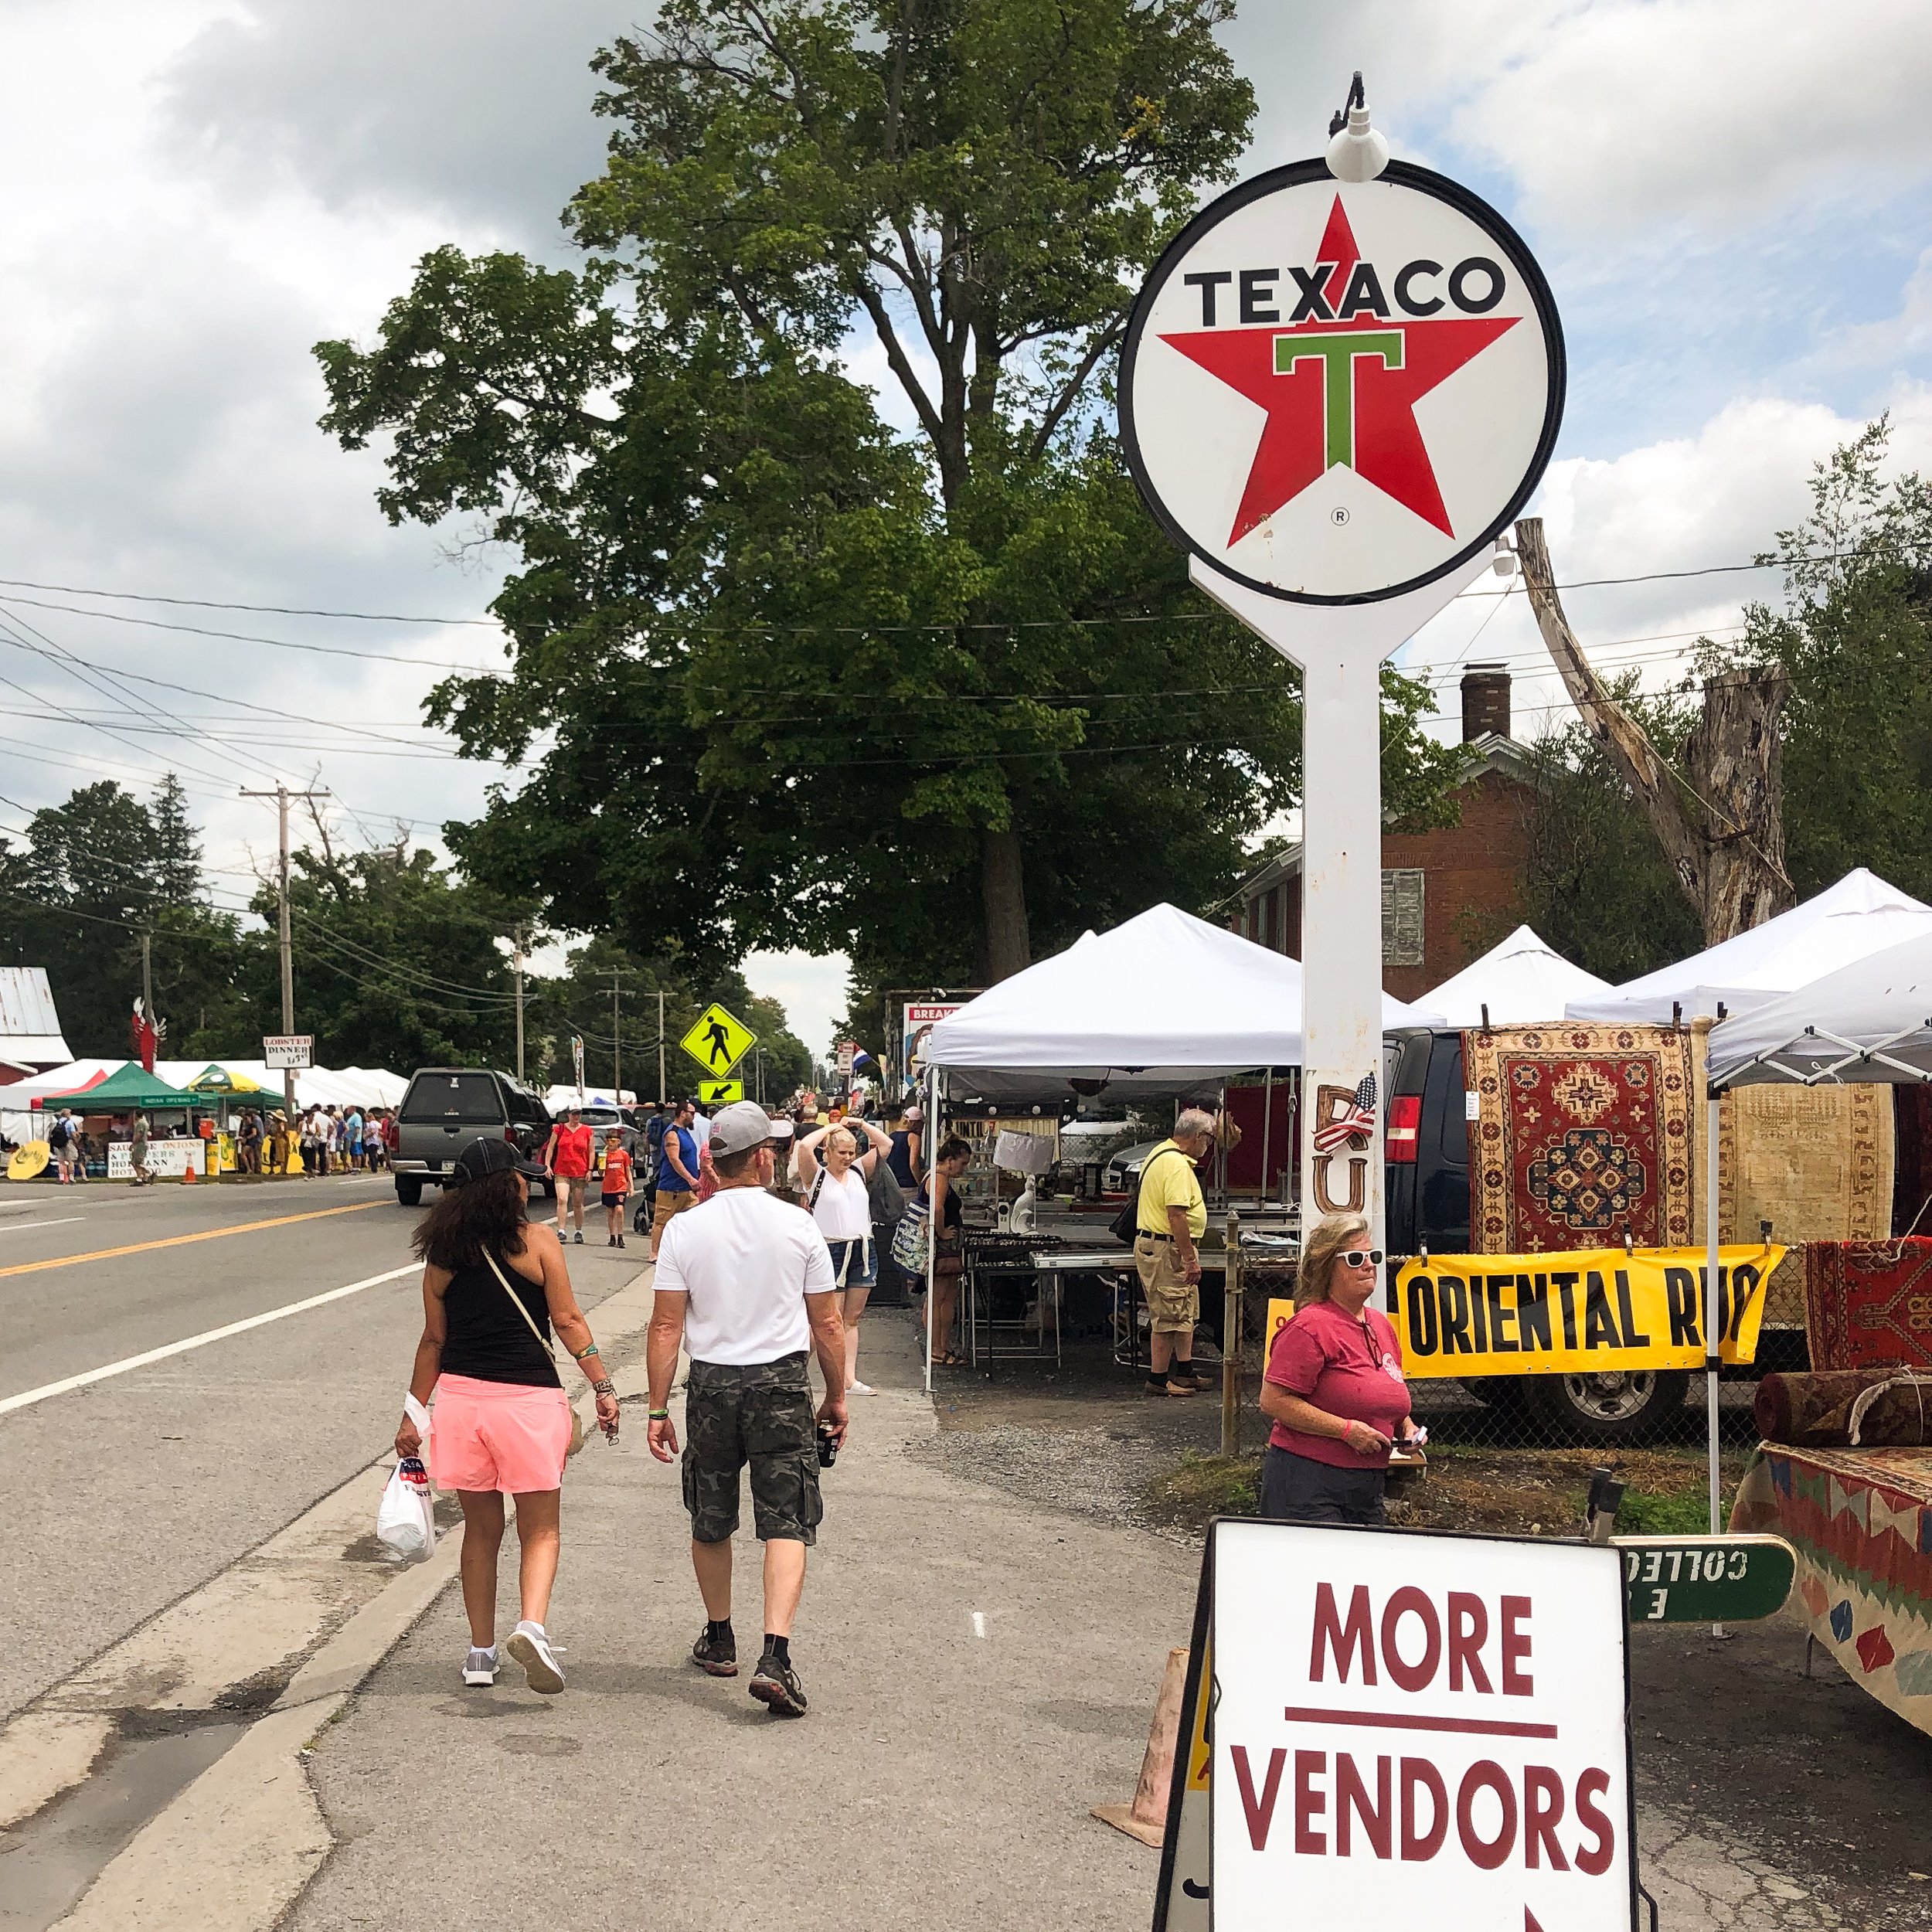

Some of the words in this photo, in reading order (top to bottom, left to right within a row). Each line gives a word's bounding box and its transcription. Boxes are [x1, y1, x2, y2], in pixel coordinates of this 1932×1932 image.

[1184, 257, 1505, 326] TEXACO
[1273, 329, 1405, 470] T
[913, 1009, 956, 1019] BREAK
[1407, 1270, 1651, 1356] ORIENTAL
[1309, 1582, 1534, 1697] MORE
[1230, 1745, 1614, 1876] VENDORS
